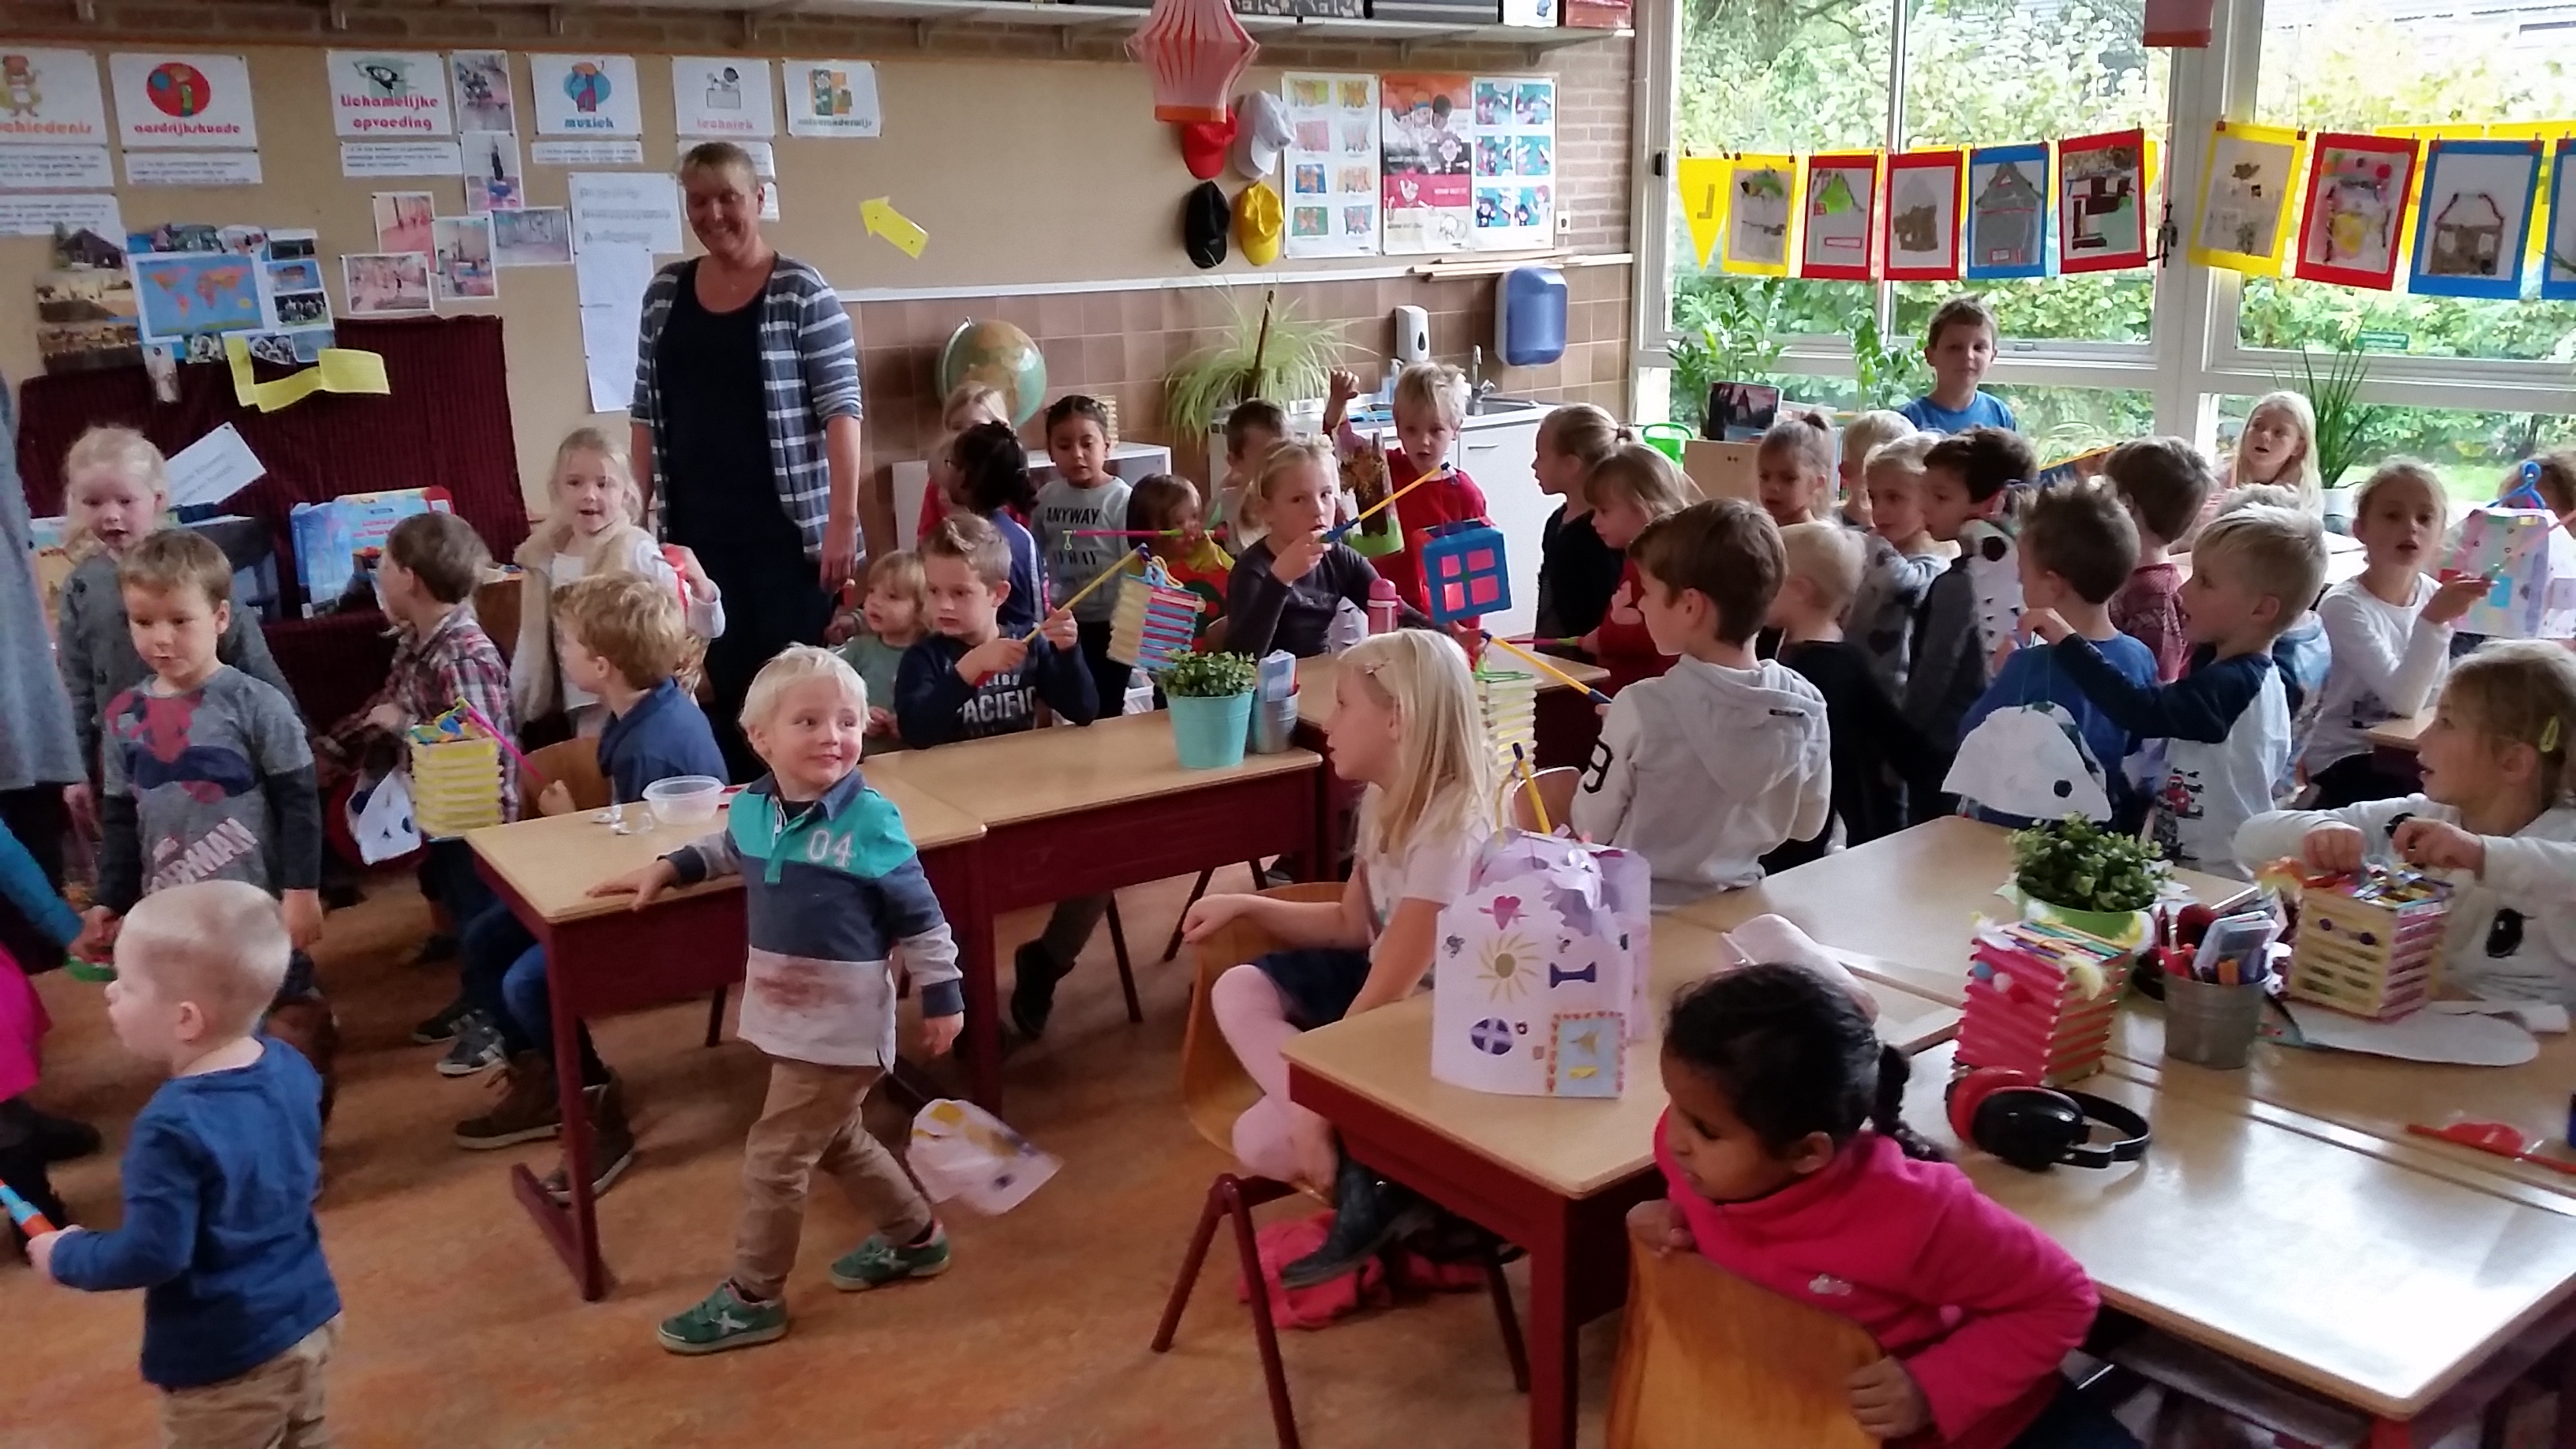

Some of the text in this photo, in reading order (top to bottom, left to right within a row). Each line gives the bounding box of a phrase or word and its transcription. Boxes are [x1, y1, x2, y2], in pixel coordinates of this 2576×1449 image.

[1046, 507, 1100, 525] ANYWAY
[956, 686, 1037, 724] ACIFIC
[808, 829, 853, 868] 04
